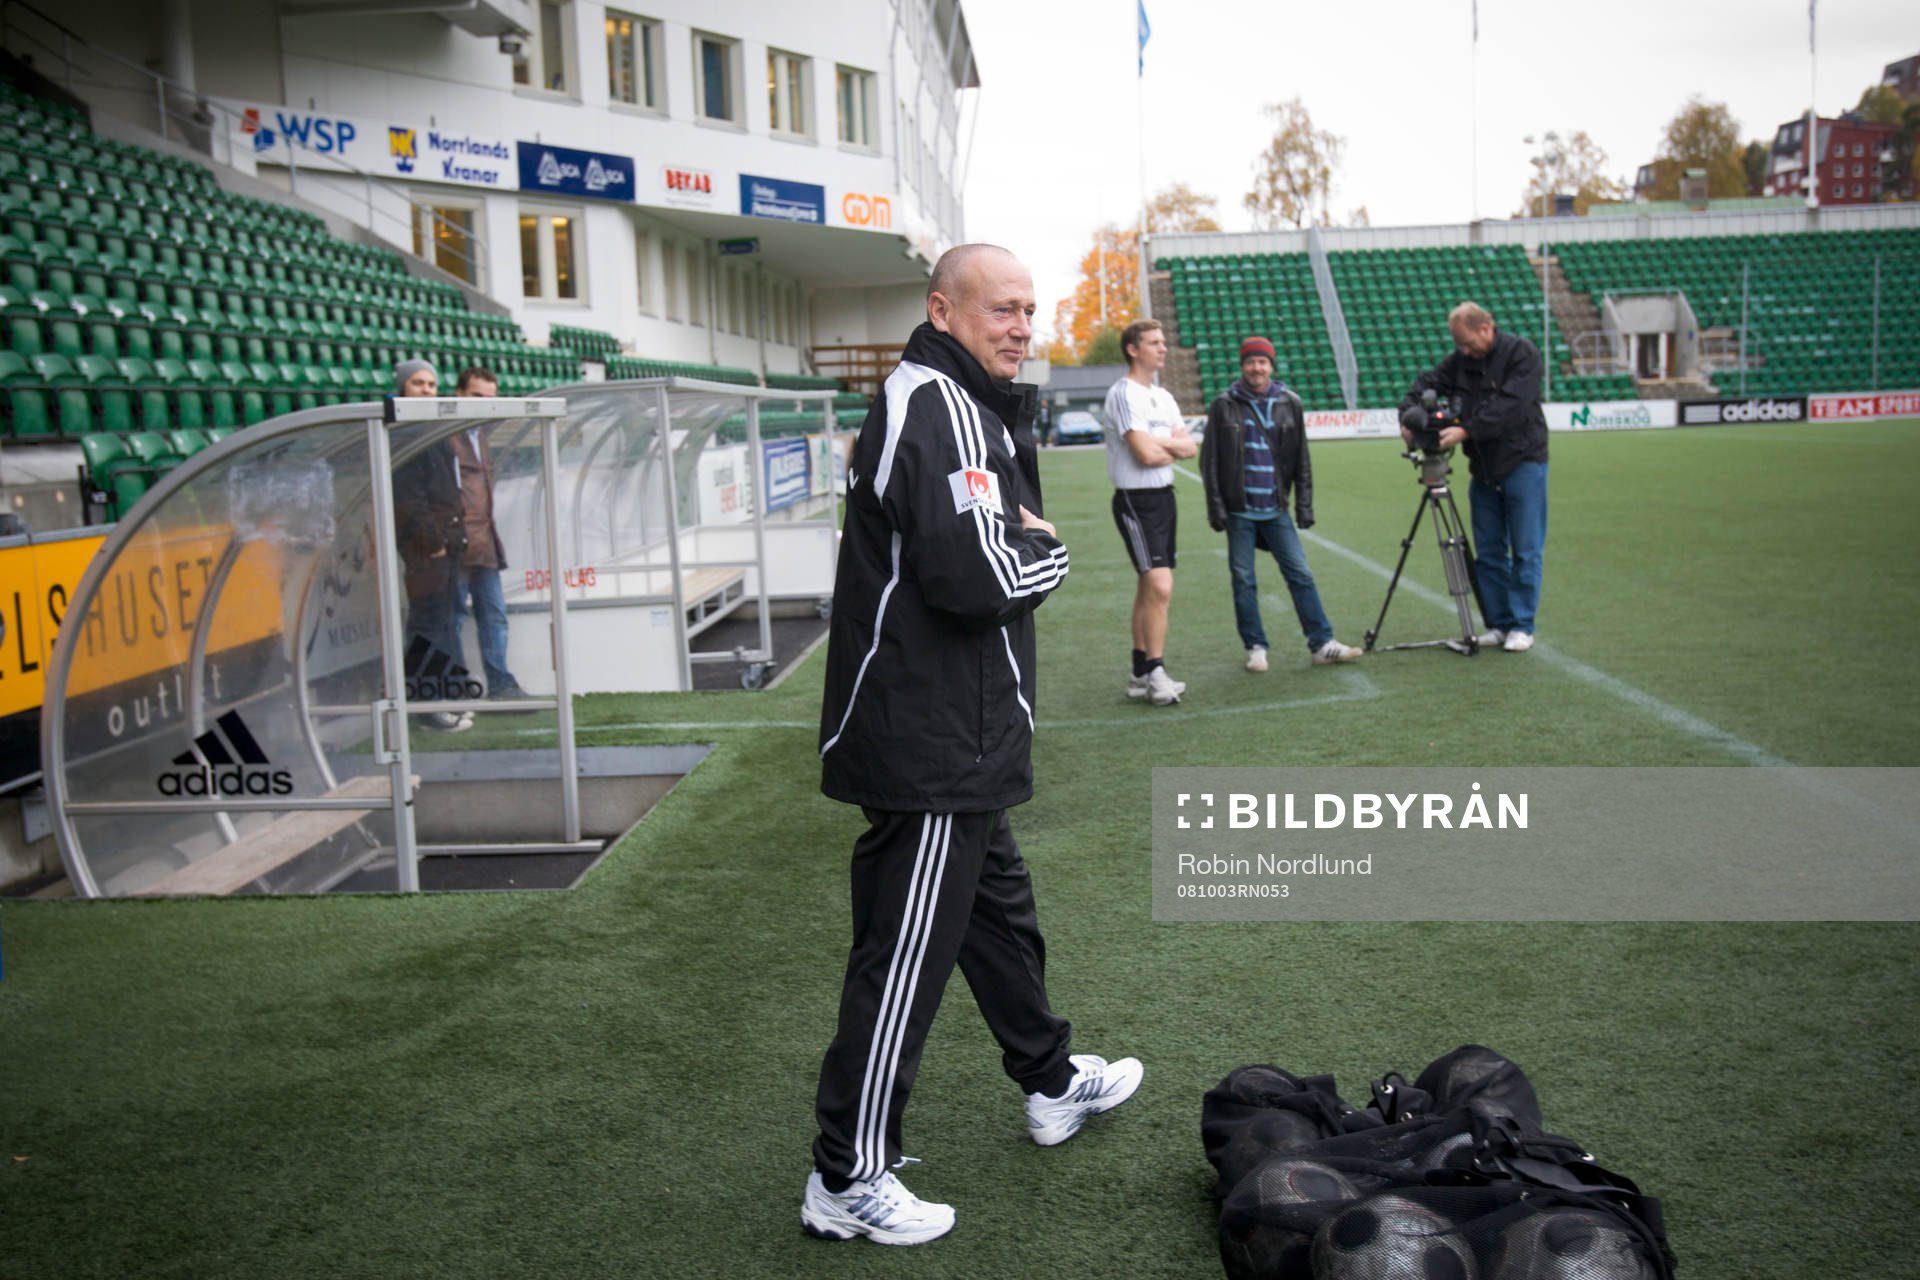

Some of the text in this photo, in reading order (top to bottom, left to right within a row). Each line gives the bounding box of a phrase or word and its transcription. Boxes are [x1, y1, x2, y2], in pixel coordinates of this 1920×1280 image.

[276, 111, 356, 154] WSP
[428, 131, 509, 160] Norrlands
[442, 156, 498, 184] Kranar
[1722, 400, 1801, 421] adidas
[1813, 398, 1874, 419] TEAM
[108, 664, 222, 737] outlt
[157, 765, 293, 796] adidas
